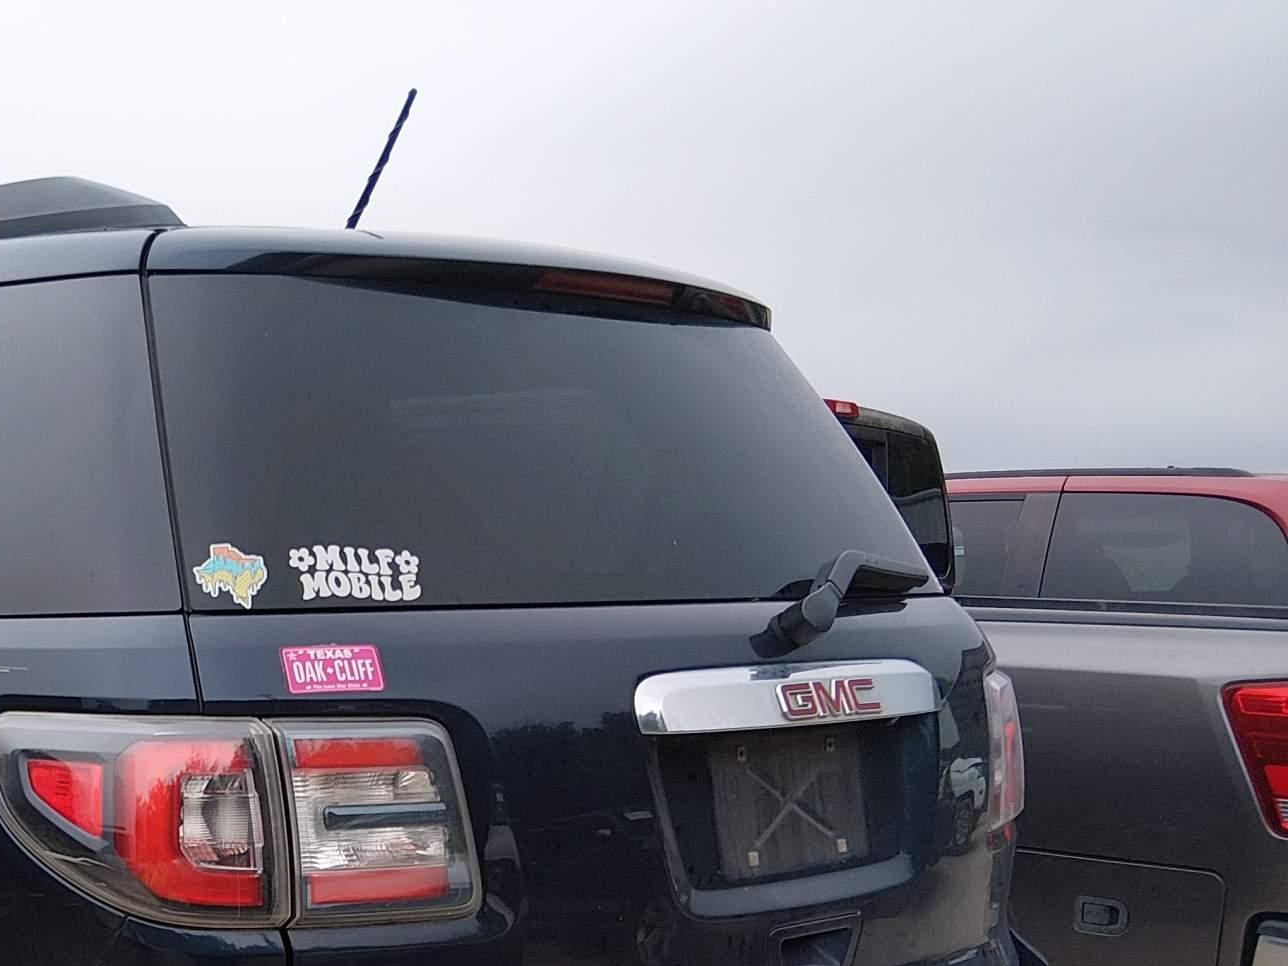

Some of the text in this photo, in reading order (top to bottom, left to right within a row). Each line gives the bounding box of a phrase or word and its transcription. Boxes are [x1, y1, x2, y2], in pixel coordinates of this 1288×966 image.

[313, 545, 395, 575] MILF
[299, 572, 421, 601] MOBILE
[309, 648, 352, 660] TEXAS
[292, 659, 374, 683] OAK CLIFF
[775, 678, 883, 720] GMC
